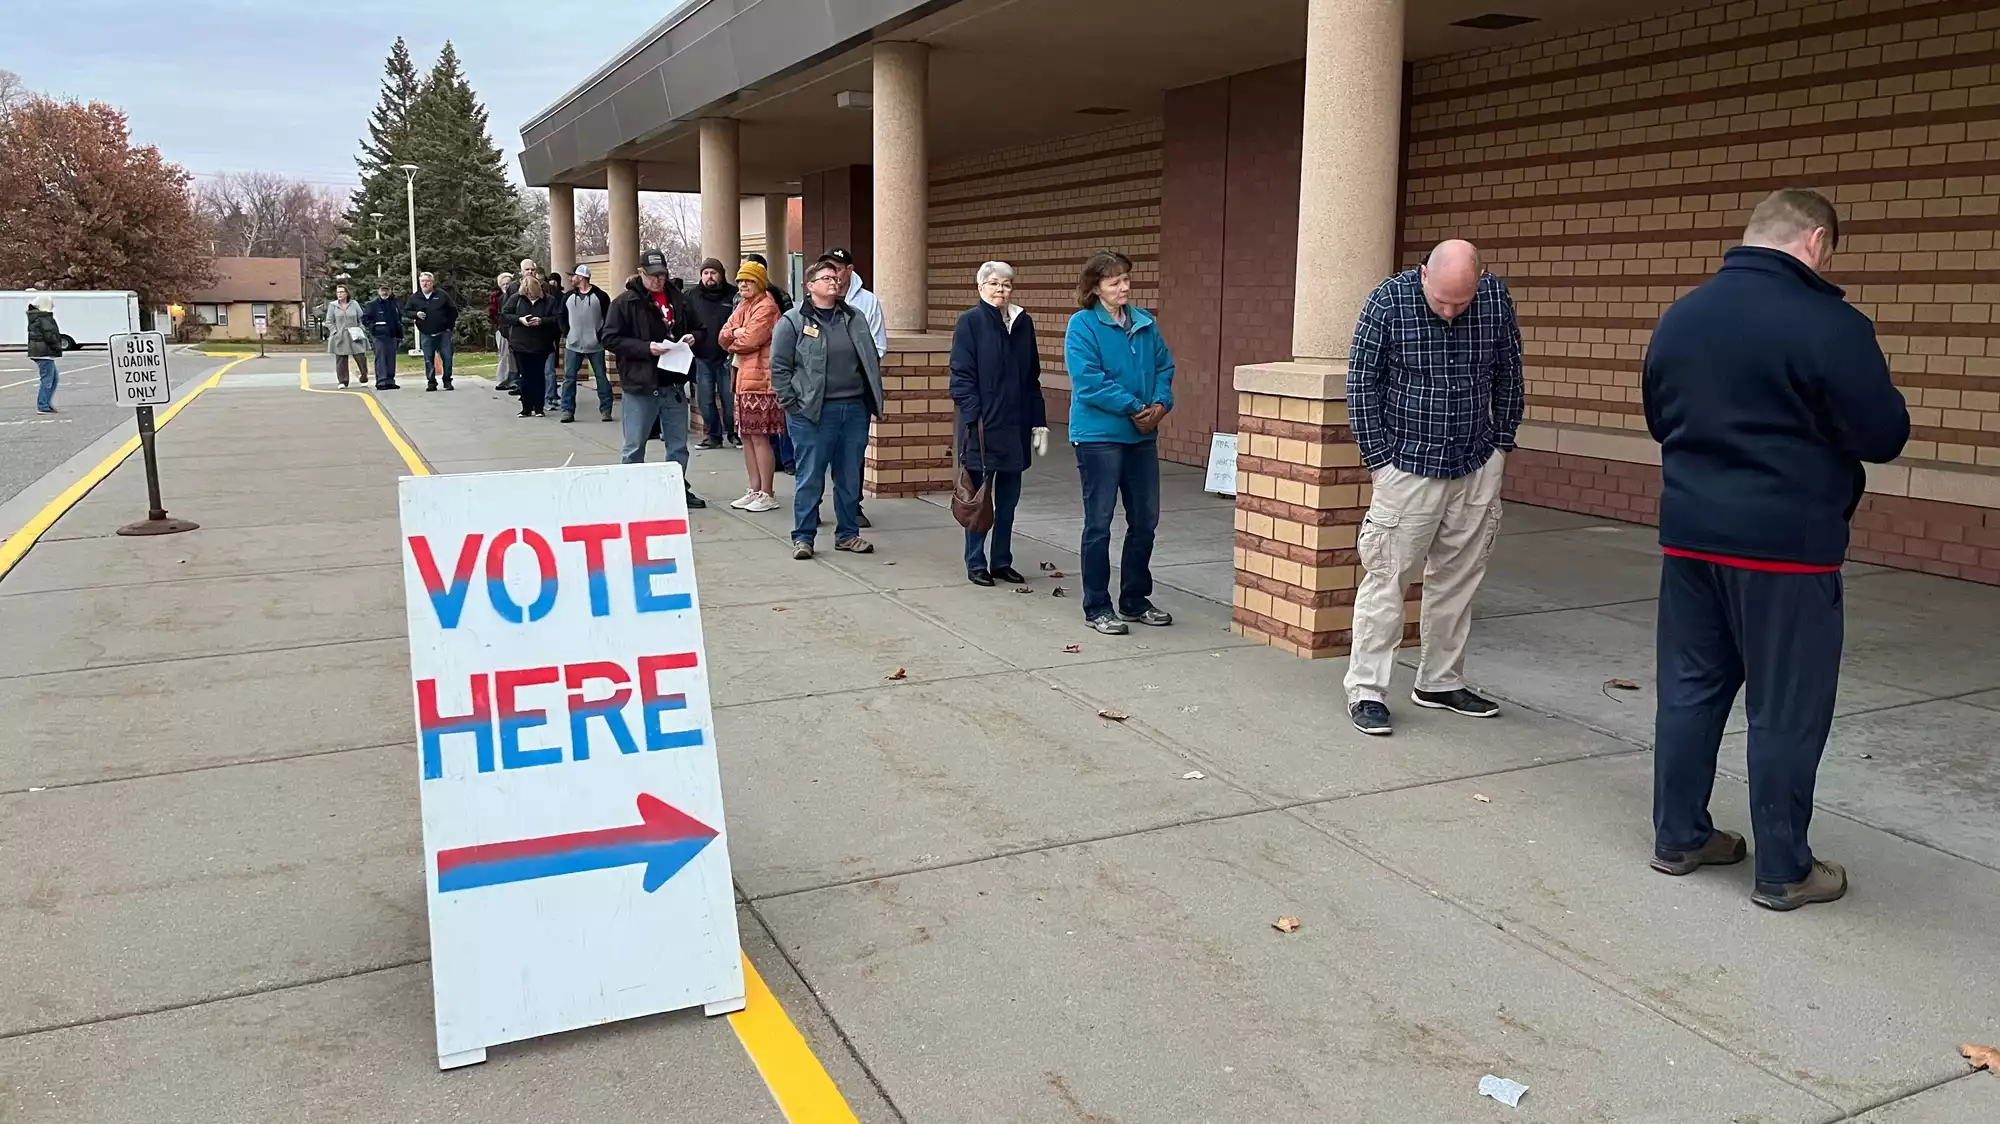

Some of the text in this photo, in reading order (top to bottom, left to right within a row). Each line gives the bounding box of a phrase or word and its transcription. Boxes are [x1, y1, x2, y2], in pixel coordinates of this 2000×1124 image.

[127, 340, 154, 353] BUS
[117, 355, 160, 368] LOADING
[125, 371, 157, 383] ZONE
[128, 386, 157, 398] ONLY
[408, 519, 692, 629] VOTE
[416, 652, 703, 780] HERE
